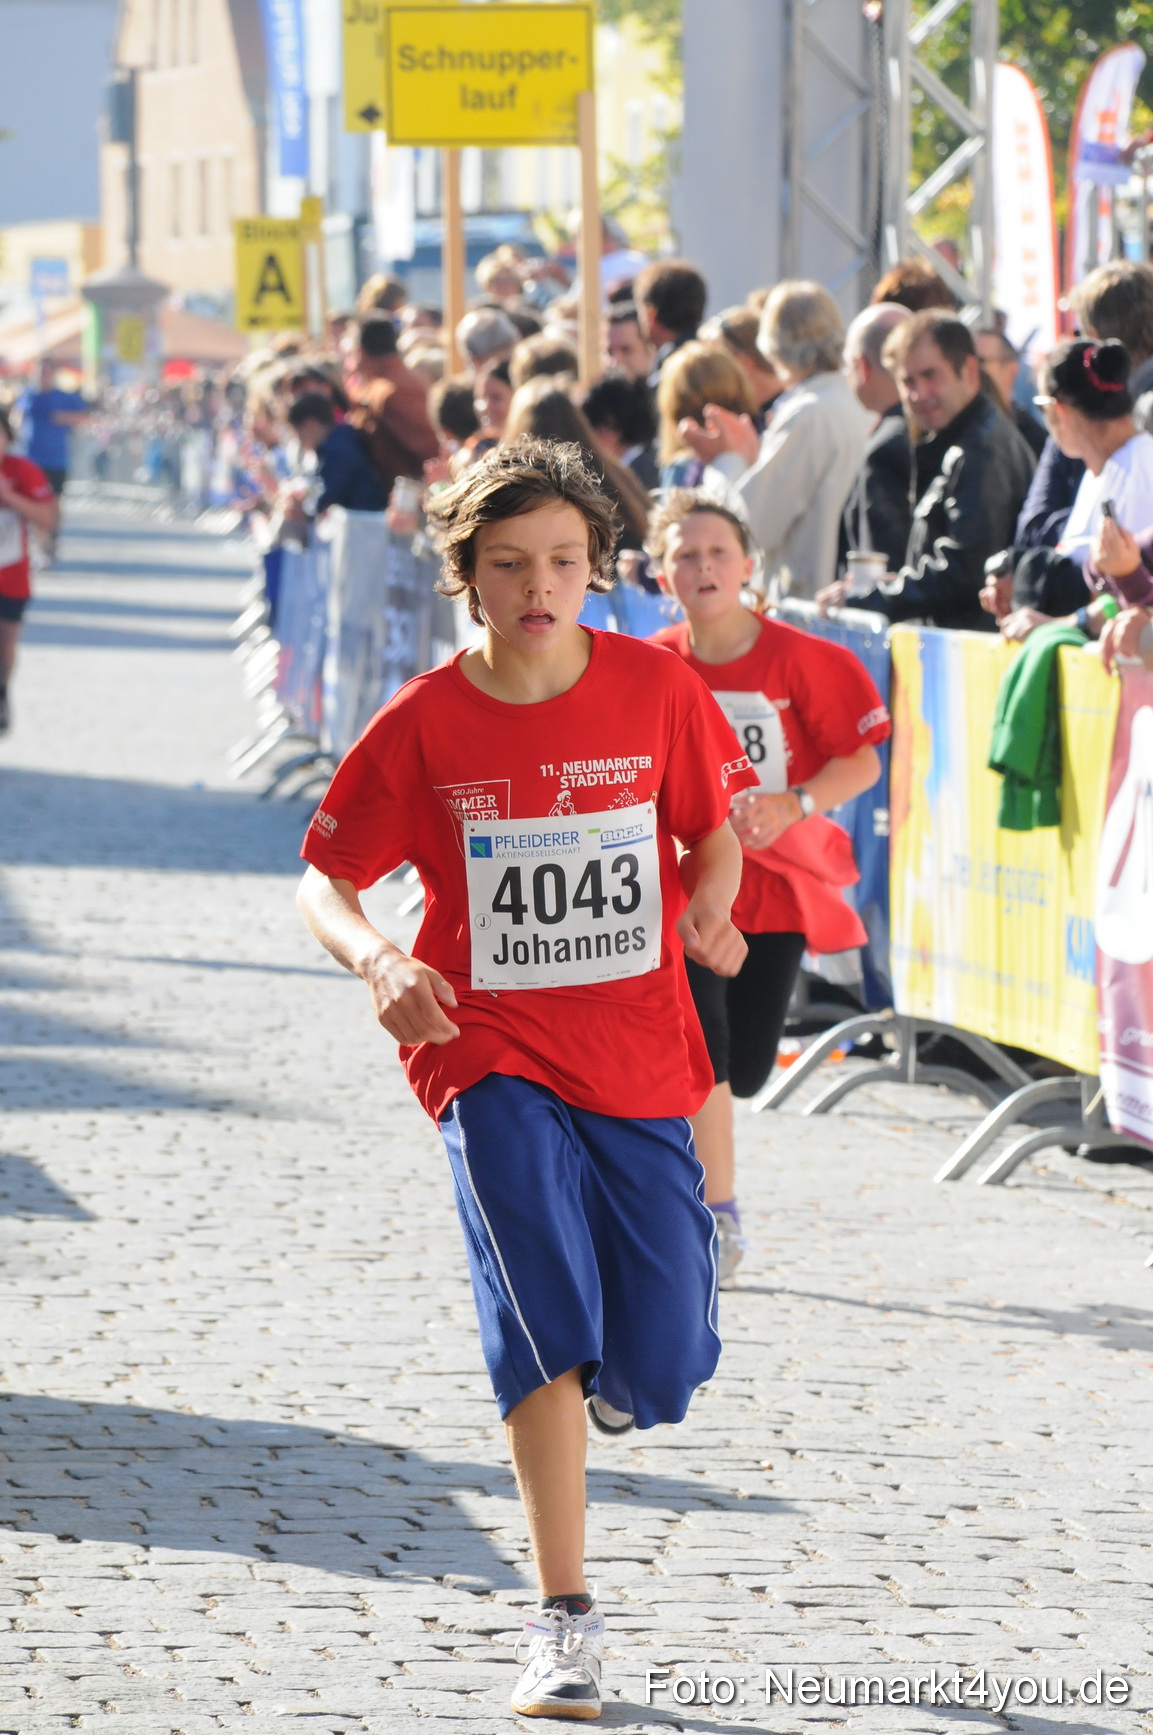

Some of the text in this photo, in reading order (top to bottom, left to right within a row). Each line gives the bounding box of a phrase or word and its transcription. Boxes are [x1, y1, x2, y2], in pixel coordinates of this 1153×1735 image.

[398, 44, 579, 76] Schnupper-
[460, 84, 517, 110] lauf
[254, 254, 293, 305] A
[539, 756, 653, 777] 11. NEUMARKTER
[559, 770, 639, 789] STADTLAUF
[452, 786, 485, 796] 850 Jahre
[495, 831, 581, 850] PFLEIDERER
[600, 823, 644, 843] BOCK
[495, 847, 582, 859] AKTIENGESELLSCHAFT
[491, 853, 642, 926] 4043
[480, 916, 486, 928] J
[493, 926, 647, 966] Johannes
